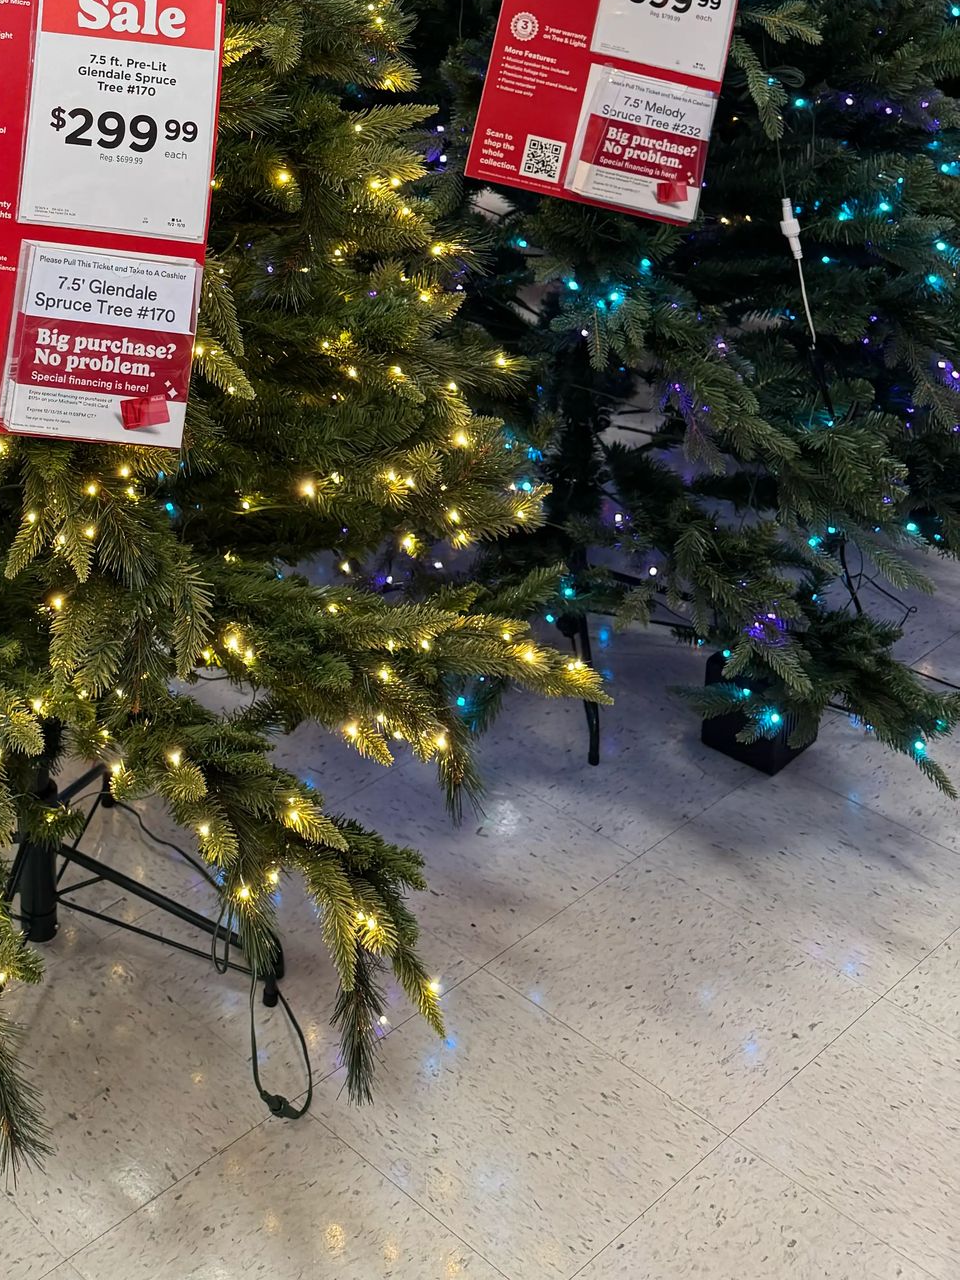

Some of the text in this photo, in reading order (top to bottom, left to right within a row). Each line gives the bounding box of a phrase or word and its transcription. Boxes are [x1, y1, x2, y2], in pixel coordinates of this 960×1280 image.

[520, 19, 529, 30] 3
[695, 13, 713, 23] each
[90, 54, 167, 72] 7.5 ft. Pre-Lit
[504, 45, 557, 64] More Features:
[78, 66, 177, 88] Glendale Spruce
[97, 81, 156, 97] Tree #170
[624, 95, 686, 122] 7.5' Melody
[485, 128, 513, 141] Scan to
[643, 113, 671, 130] Tree
[672, 123, 701, 138] #232
[484, 138, 515, 151] shop the
[605, 126, 697, 157] Big purchase?
[99, 153, 144, 165] Reg. $699.99
[164, 150, 188, 160] each
[479, 157, 517, 172] collection.
[481, 148, 504, 159] whole
[602, 140, 682, 169] No problem.
[599, 155, 624, 167] Special
[624, 161, 654, 176] financing
[653, 167, 661, 176] is
[660, 170, 677, 179] here!
[39, 254, 187, 281] Please Pull This Ticket and Take to A Cashier
[58, 276, 157, 301] 7.5' Glendale
[35, 292, 175, 323] Spruce Tree #170
[35, 328, 177, 359] Big purchase?
[33, 347, 155, 377] No problem.
[31, 370, 149, 393] Special financing is here!
